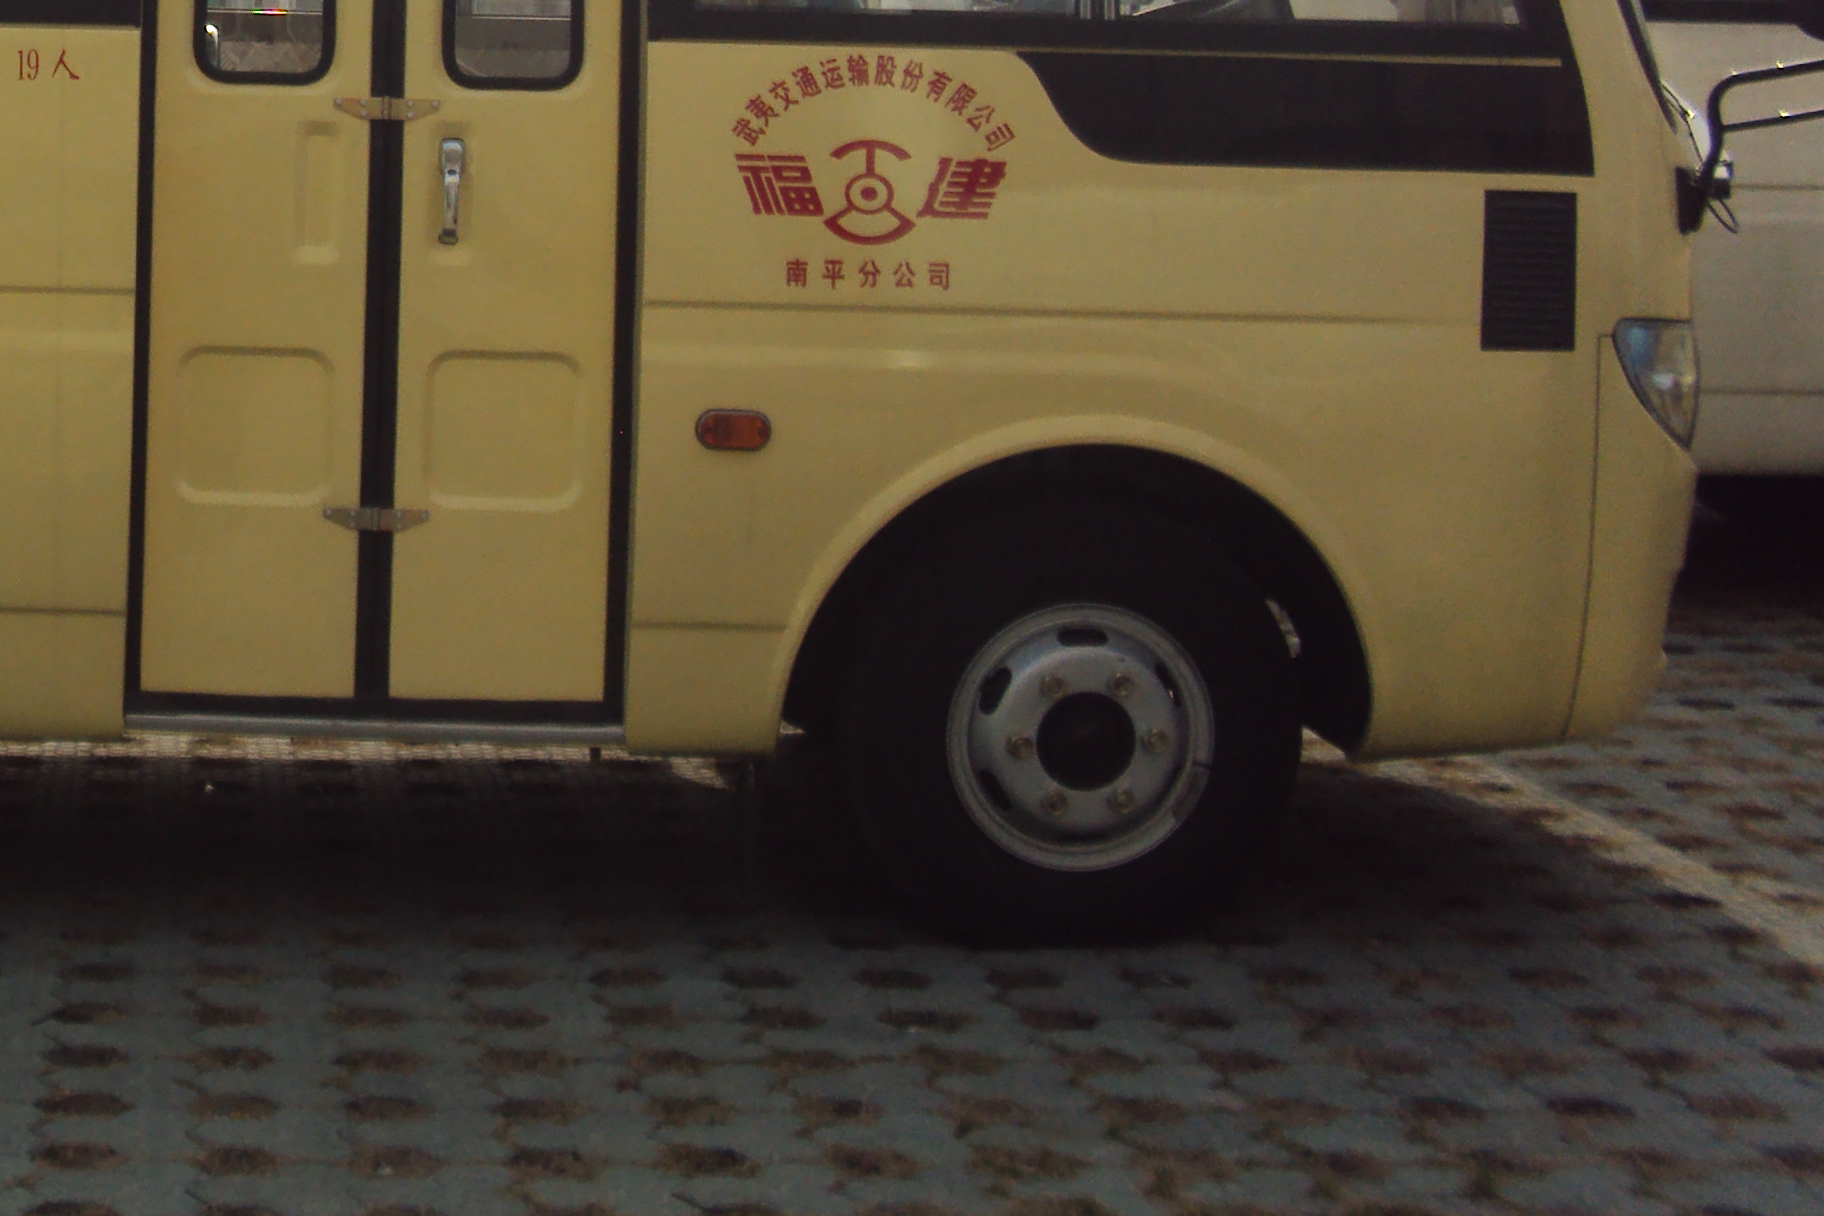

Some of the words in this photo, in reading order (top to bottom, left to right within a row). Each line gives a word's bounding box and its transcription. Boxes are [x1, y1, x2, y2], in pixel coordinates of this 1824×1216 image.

[731, 54, 1016, 153] 武夷交通运输股份有限公司
[785, 257, 951, 292] 南平分公司
